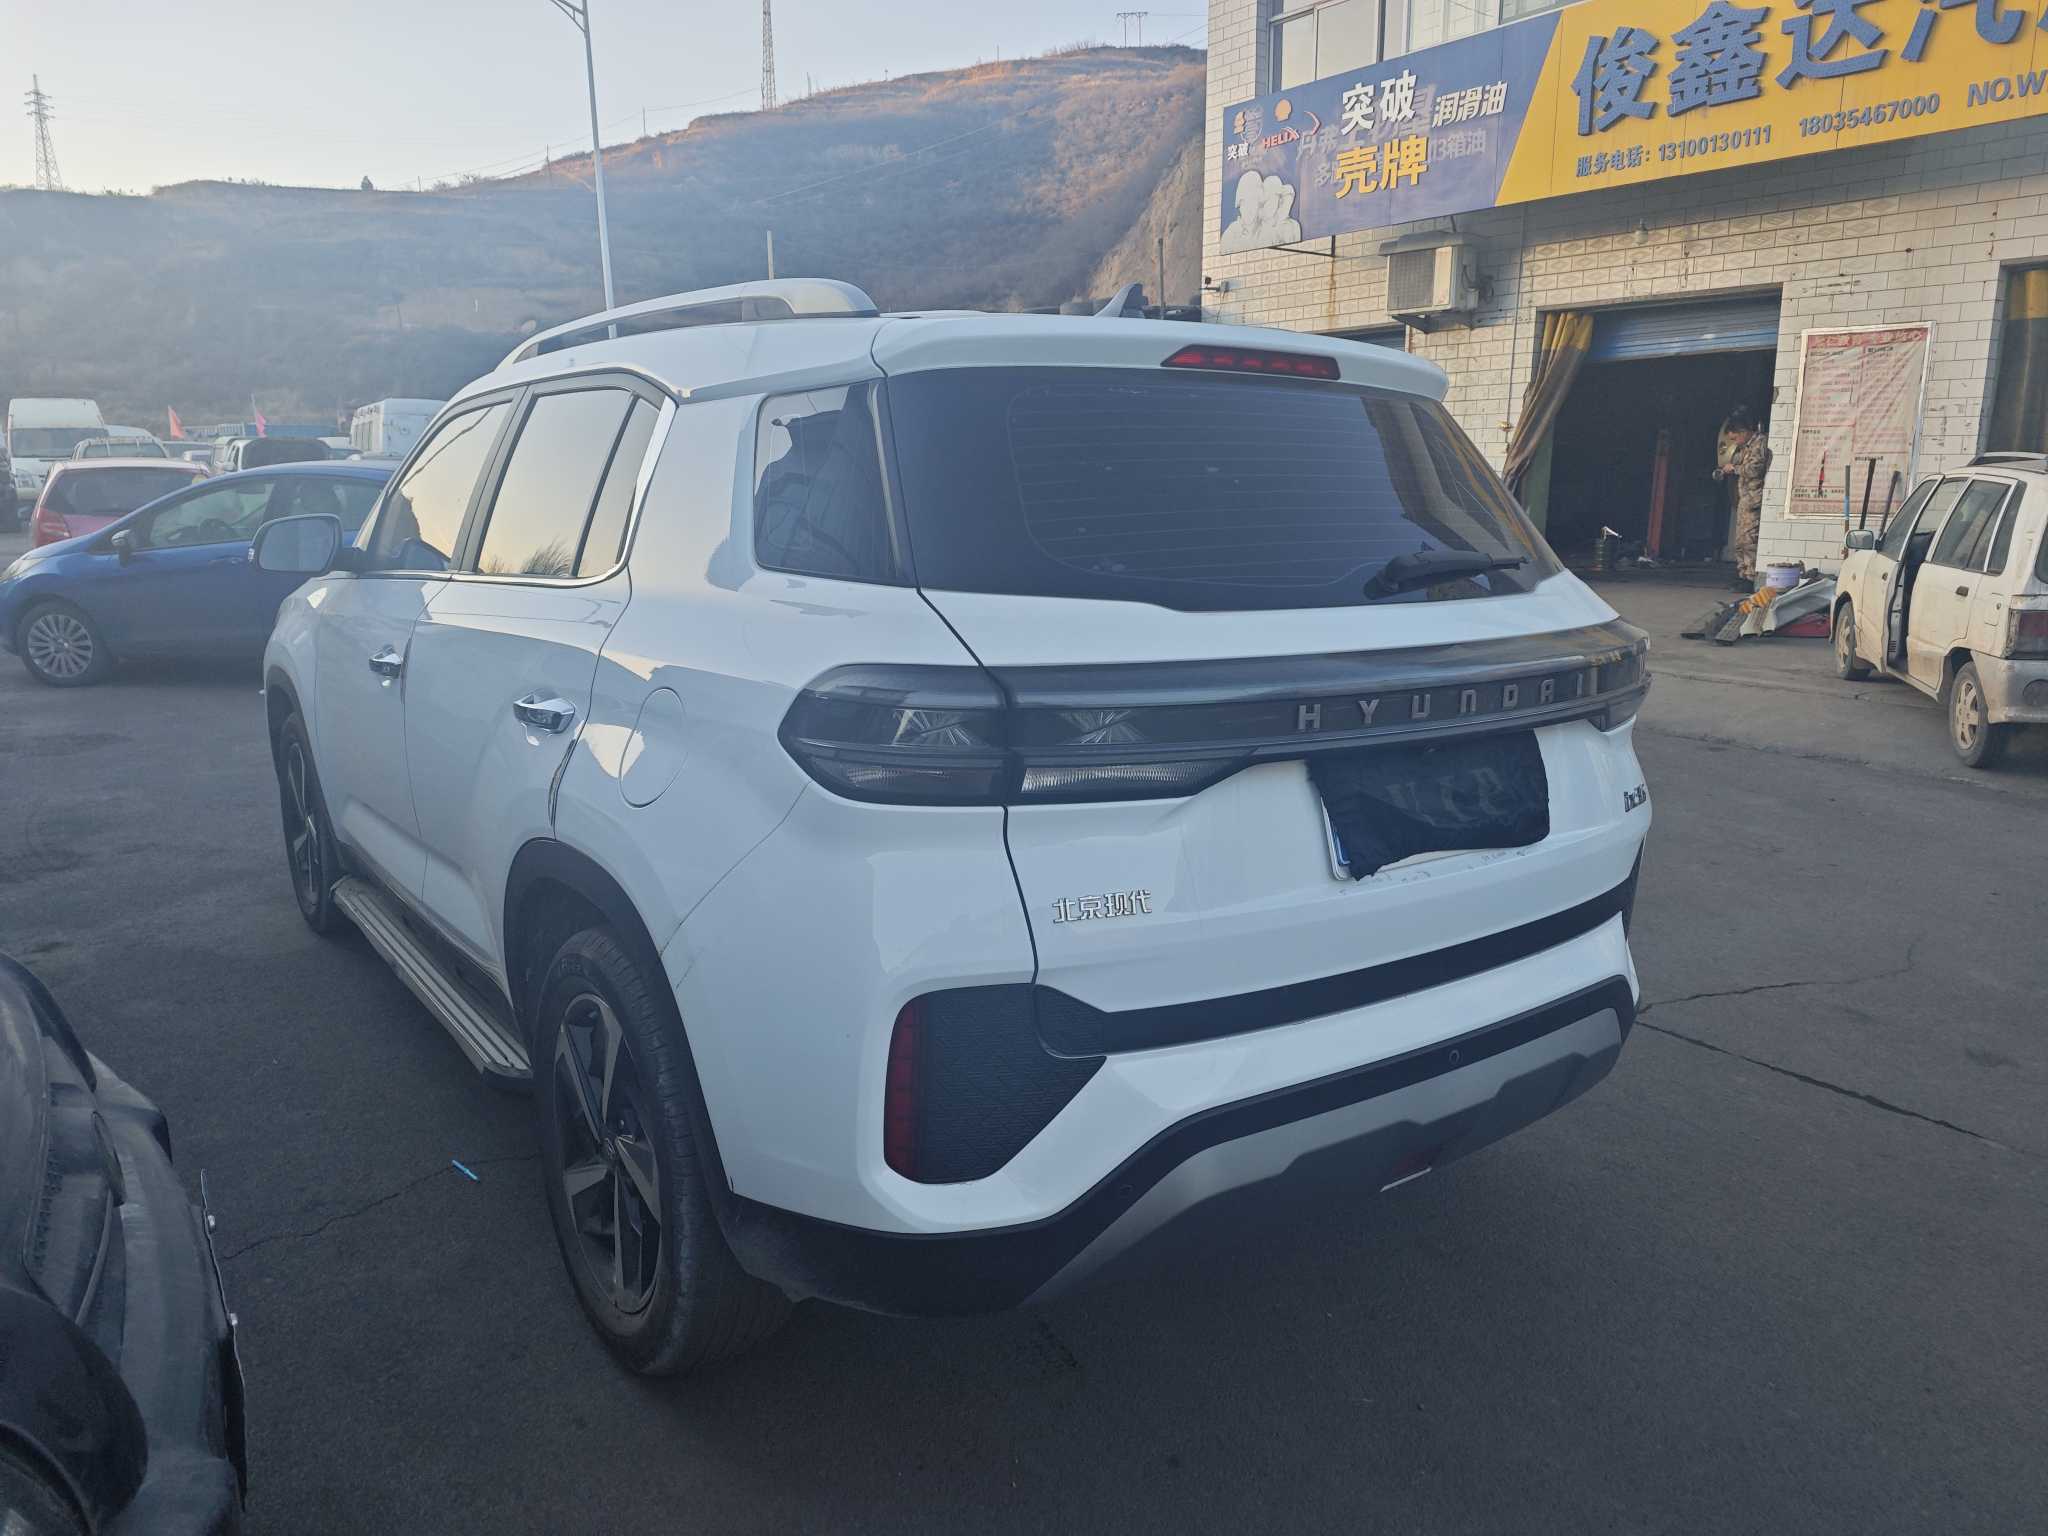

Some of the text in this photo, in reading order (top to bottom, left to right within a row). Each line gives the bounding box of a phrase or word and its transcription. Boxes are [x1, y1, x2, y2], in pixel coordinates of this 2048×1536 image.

[1571, 0, 2048, 136] 俊鑫达汽
[1341, 69, 1417, 136] 突破
[1432, 81, 1508, 128] 润滑油
[1799, 93, 1941, 138] 18035467000
[1335, 134, 1429, 200] 壳牌
[1298, 672, 1584, 732] HYUNDAI
[1052, 889, 1152, 924] 北京现代
